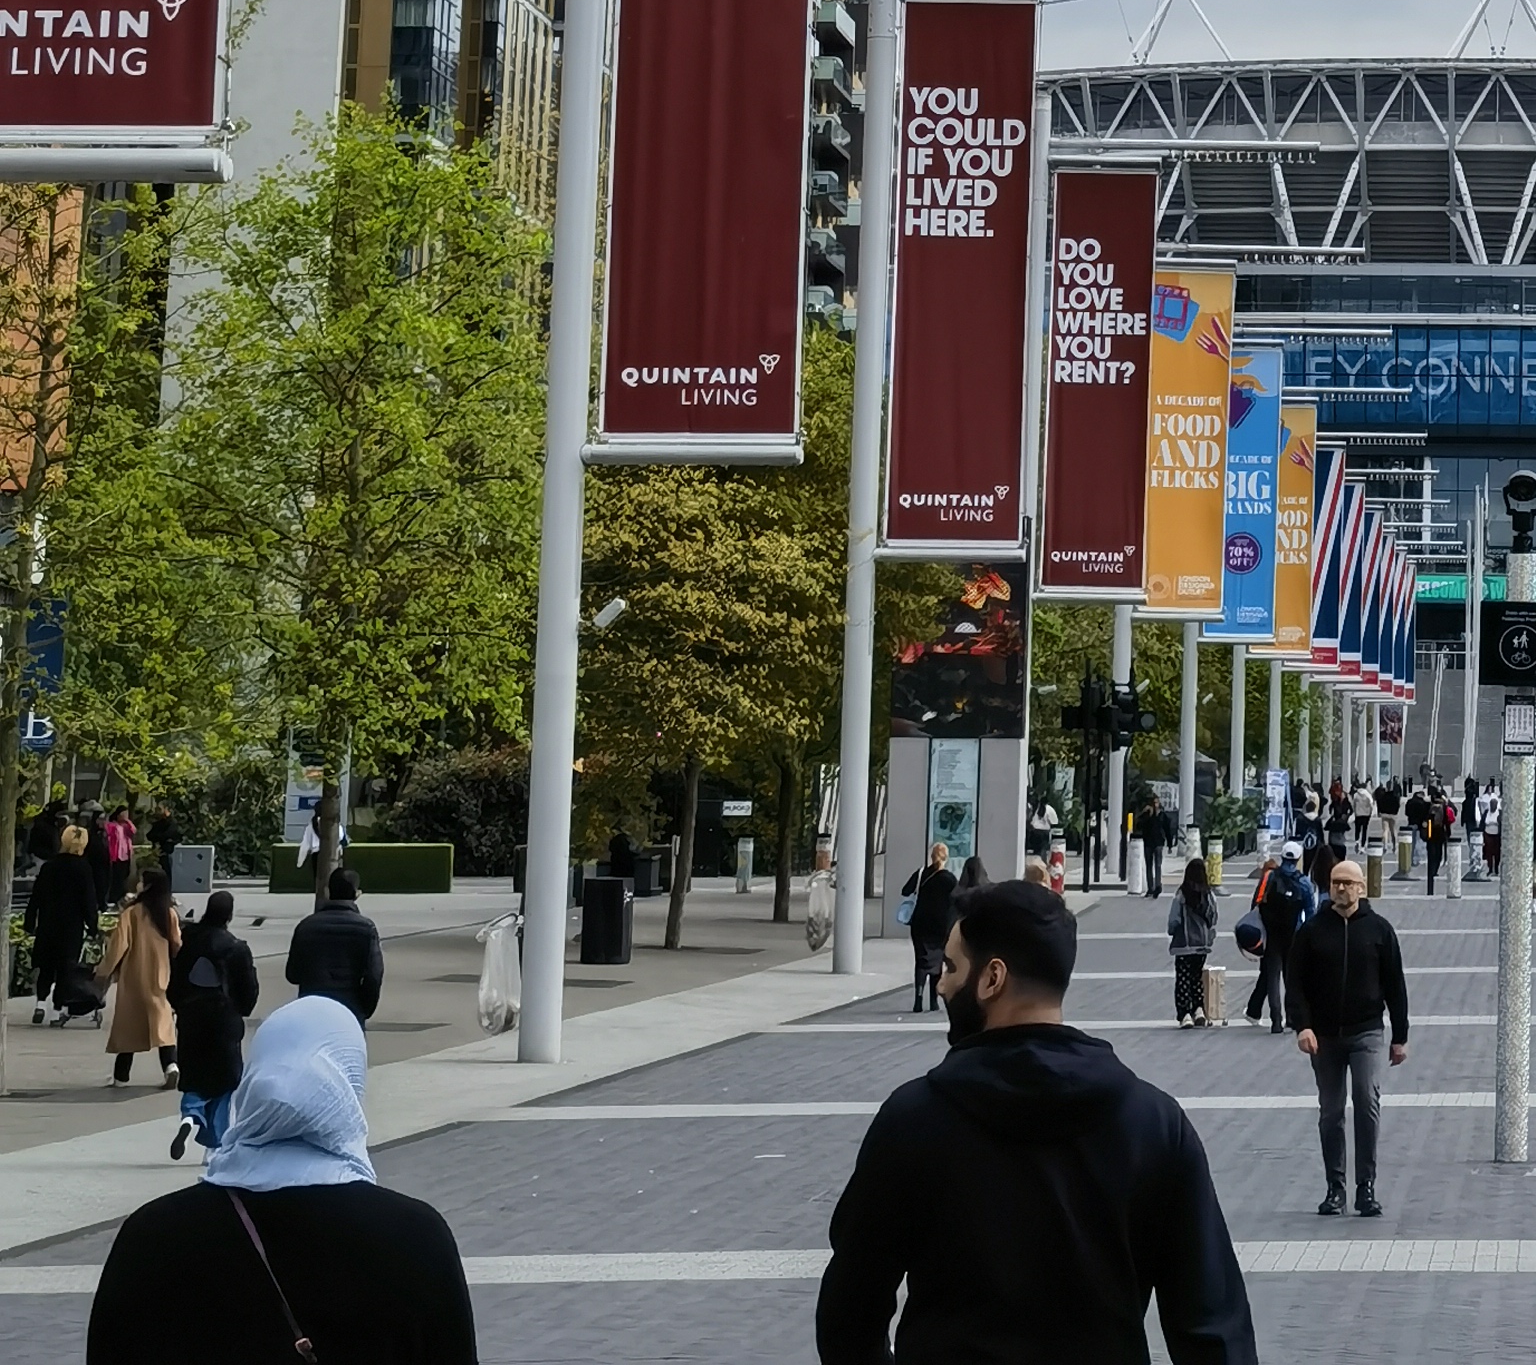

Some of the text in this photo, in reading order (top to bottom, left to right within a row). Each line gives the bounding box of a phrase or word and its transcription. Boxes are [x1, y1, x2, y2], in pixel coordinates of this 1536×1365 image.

[11, 47, 147, 76] LIVING
[909, 87, 979, 115] YOU
[907, 117, 1026, 146] COULD
[906, 147, 1013, 177] IF YOU
[905, 178, 998, 207] LIVED
[904, 208, 994, 237] HERE.
[1058, 238, 1101, 261] DO
[1058, 263, 1114, 286] YOU
[1057, 287, 1124, 311] LOVE
[1055, 312, 1147, 336] WHERE
[1055, 335, 1112, 360] YOU
[621, 367, 758, 387] QUINTAIN
[1054, 360, 1136, 384] RENT?
[681, 389, 758, 406] LIVING
[1153, 413, 1222, 437] FOOD
[1152, 438, 1221, 468] AND
[1150, 469, 1219, 489] FLICKS
[899, 494, 994, 508] QUINTAIN
[940, 509, 994, 522] LIVING
[1277, 509, 1308, 528] OD
[1050, 550, 1124, 563] QUINTAIN
[1228, 546, 1254, 557] 70%
[1082, 563, 1124, 574] LIVING
